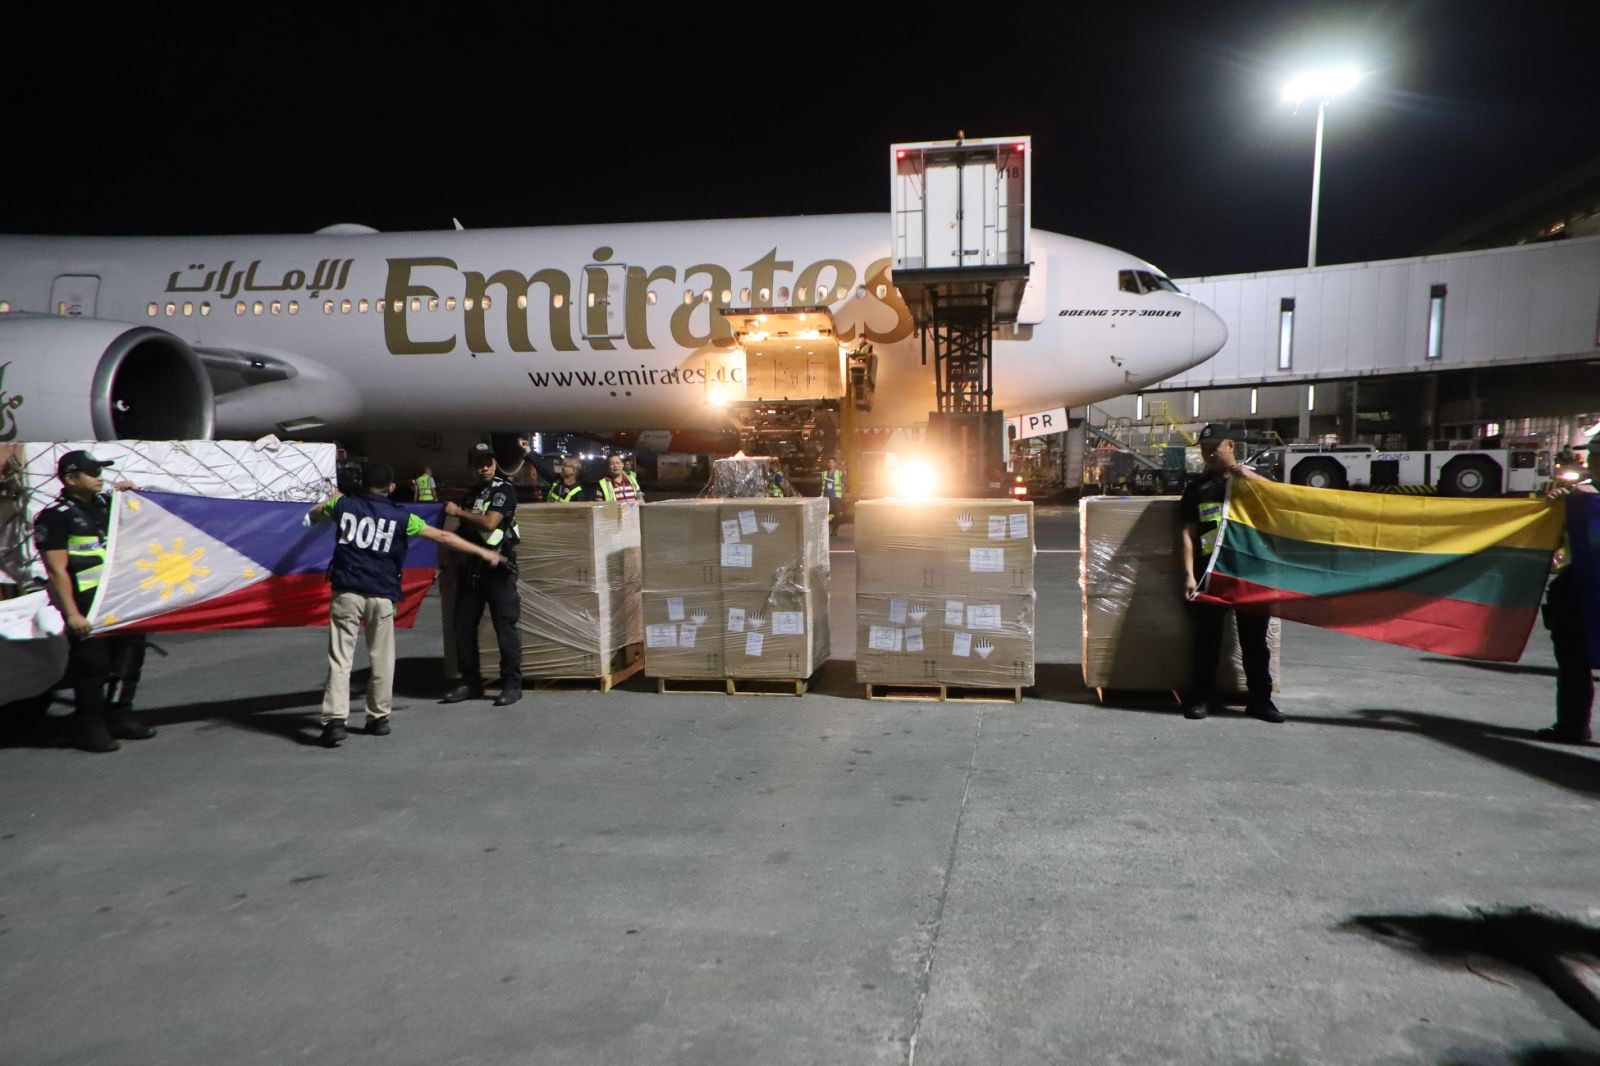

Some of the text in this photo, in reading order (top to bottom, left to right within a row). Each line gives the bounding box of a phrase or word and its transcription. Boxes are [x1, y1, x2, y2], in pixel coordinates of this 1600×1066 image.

[165, 258, 354, 298] الإمارات
[383, 245, 915, 356] Emirates
[1059, 309, 1110, 318] BOEING
[1029, 414, 1053, 431] PR
[338, 511, 397, 553] DOH
